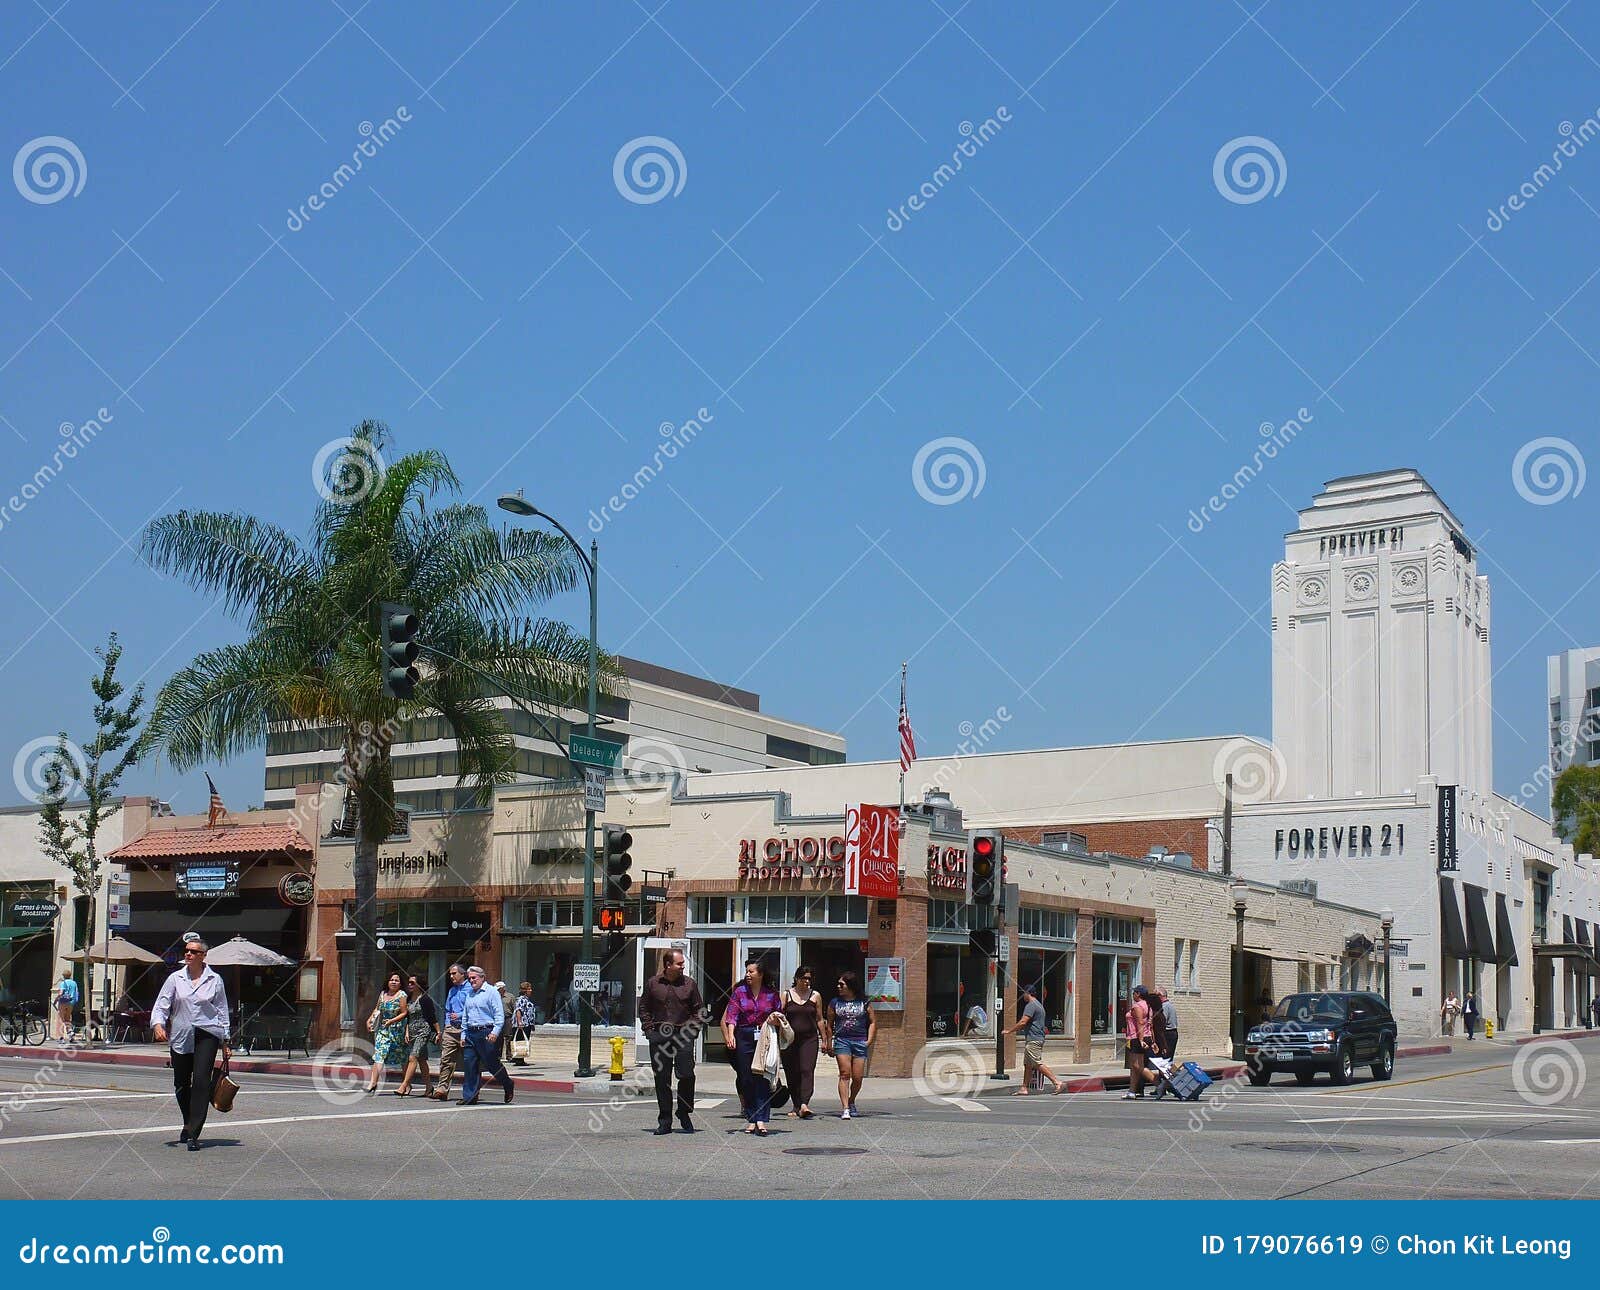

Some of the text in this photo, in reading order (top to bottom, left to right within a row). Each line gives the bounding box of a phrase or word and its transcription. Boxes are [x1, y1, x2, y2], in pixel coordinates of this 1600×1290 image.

[1320, 526, 1404, 552] FOREVER 21
[573, 743, 604, 760] Delacey
[586, 772, 606, 786] DO NOT
[586, 786, 605, 799] BLOCK
[870, 811, 890, 858] 21
[1275, 824, 1404, 851] FOREVER 21
[738, 836, 846, 863] 21 CHOIC
[379, 849, 448, 873] unglass hut
[944, 846, 968, 873] CH
[1443, 858, 1452, 868] 21
[738, 865, 846, 879] FROZEN YOG
[931, 874, 967, 889] FROZE
[614, 911, 623, 926] 14
[664, 921, 675, 932] 87
[574, 979, 584, 989] OK
